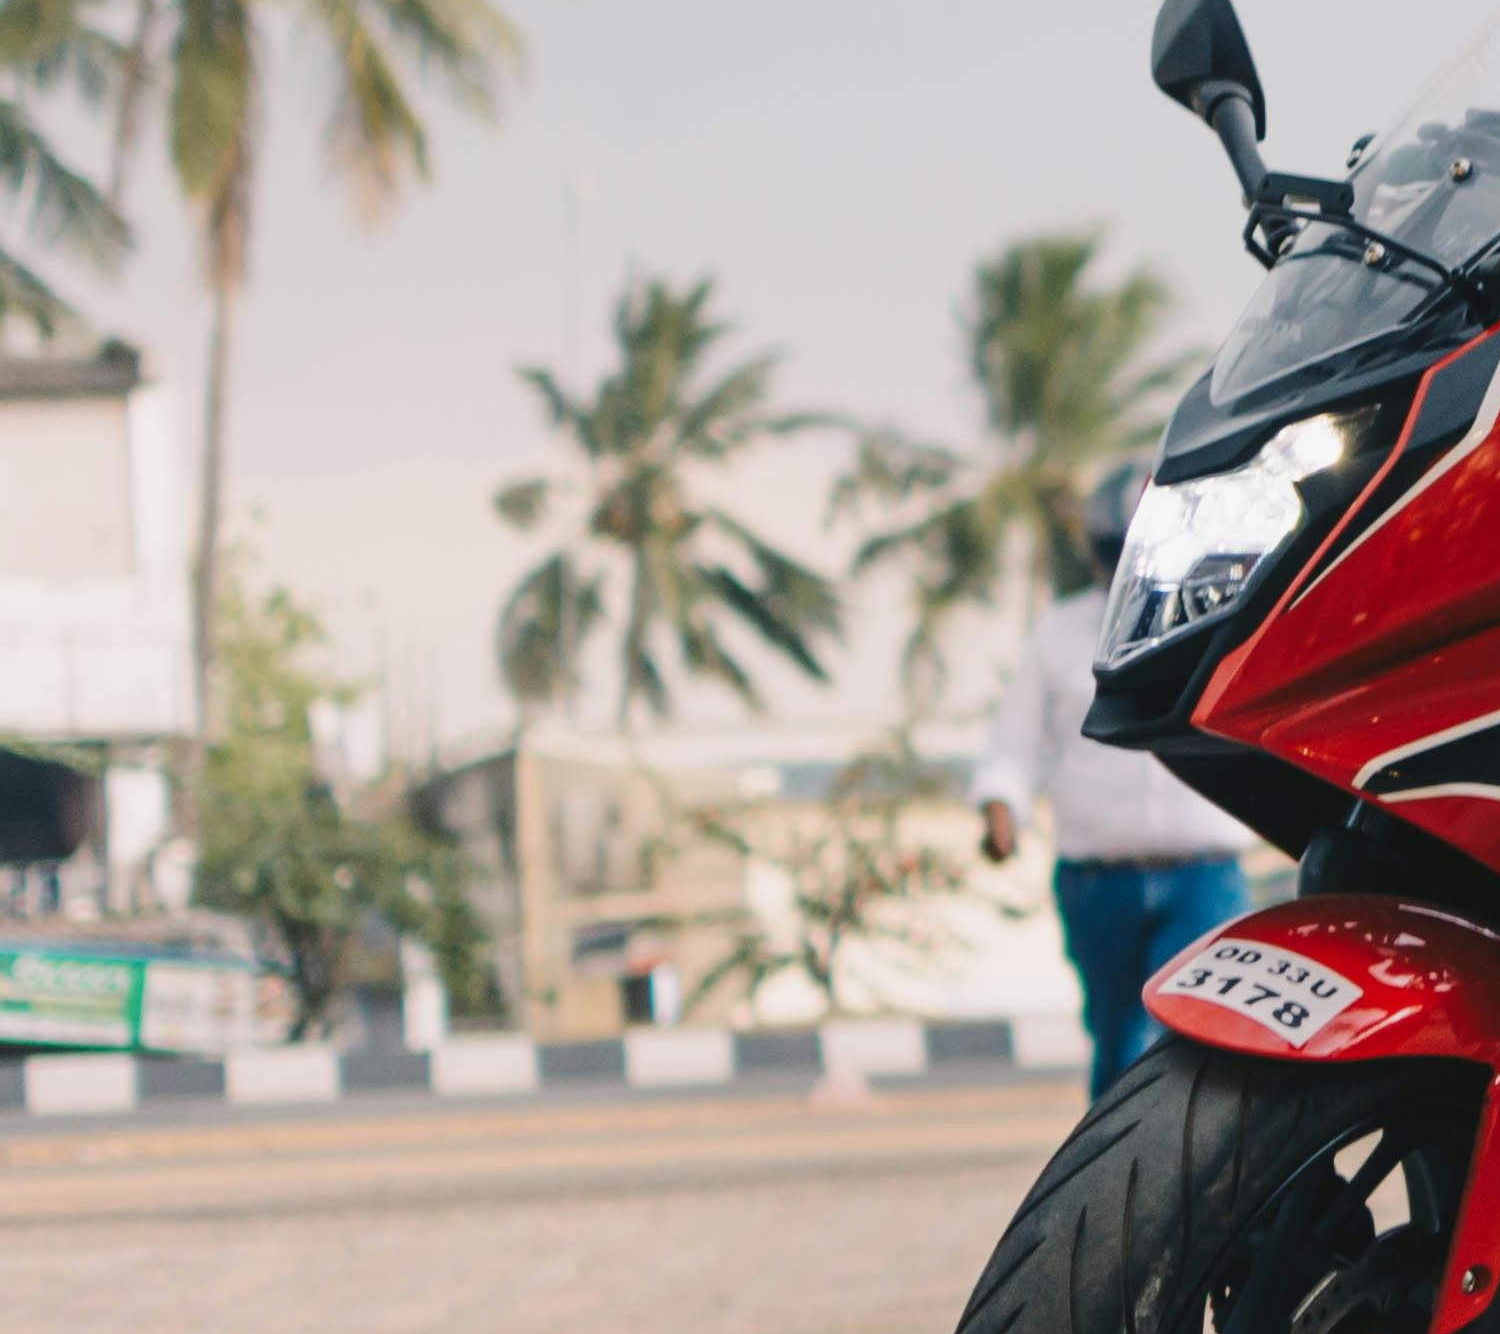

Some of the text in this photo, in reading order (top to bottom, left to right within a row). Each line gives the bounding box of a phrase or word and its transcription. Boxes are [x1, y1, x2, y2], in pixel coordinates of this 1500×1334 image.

[1176, 968, 1311, 1029] 3178
[1215, 946, 1338, 999] OD 33U
